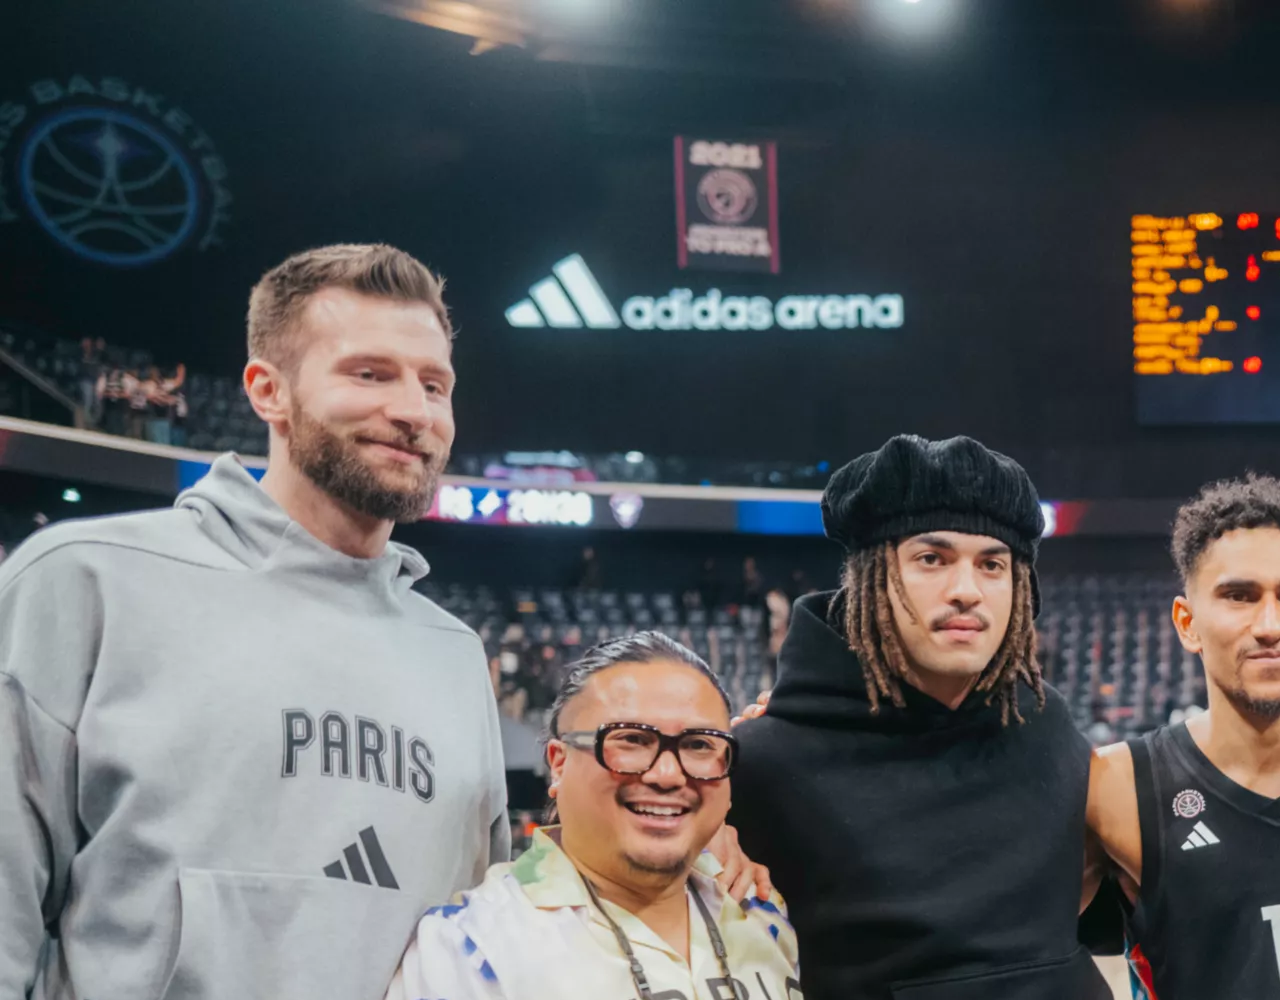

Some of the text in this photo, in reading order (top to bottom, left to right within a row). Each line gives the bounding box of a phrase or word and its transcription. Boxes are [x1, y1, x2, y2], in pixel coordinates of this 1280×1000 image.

[621, 288, 904, 330] adidas arena
[281, 708, 436, 804] PARIS
